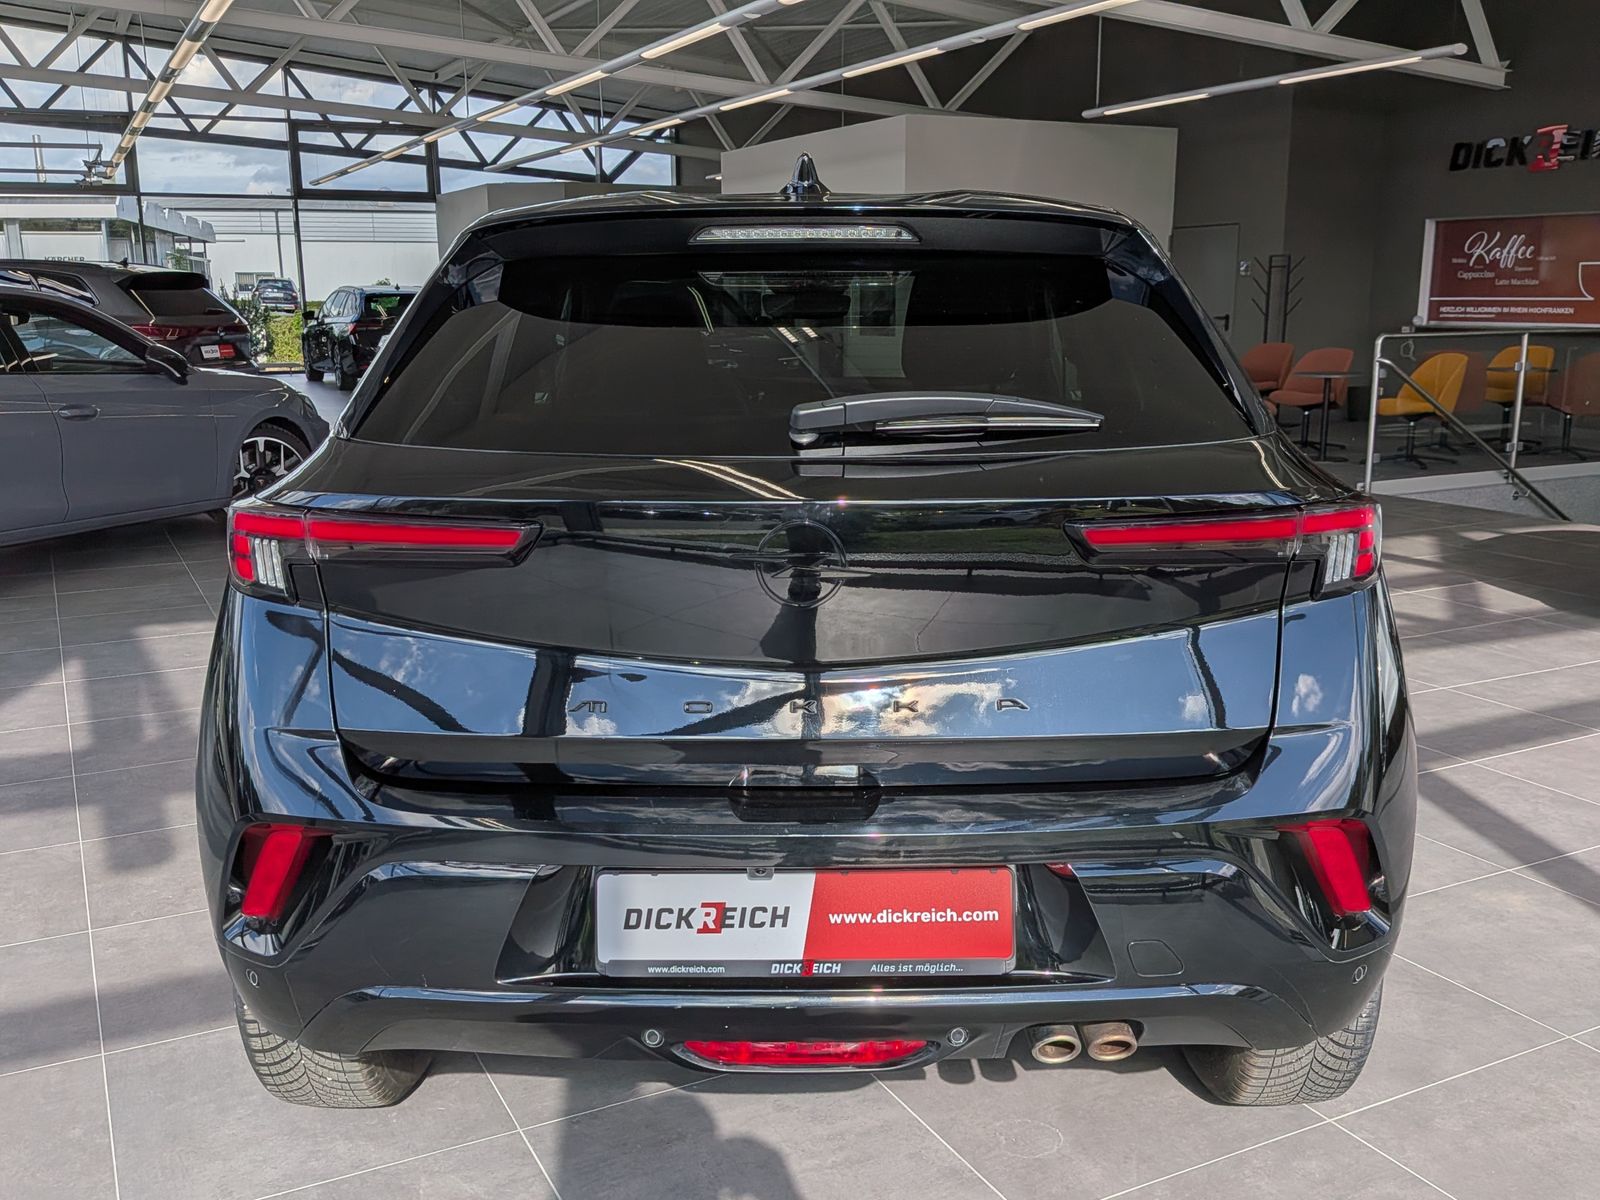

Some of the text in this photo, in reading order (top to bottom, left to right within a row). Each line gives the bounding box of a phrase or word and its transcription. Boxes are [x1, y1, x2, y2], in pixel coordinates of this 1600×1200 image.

[1464, 231, 1535, 268] Kaffee
[623, 902, 790, 934] DICKREICH
[828, 908, 999, 924] www.dickreich.com
[647, 965, 725, 974] www.dickreich.com
[770, 961, 842, 976] DICKREICH
[870, 963, 963, 974] Alles ist möglich...
